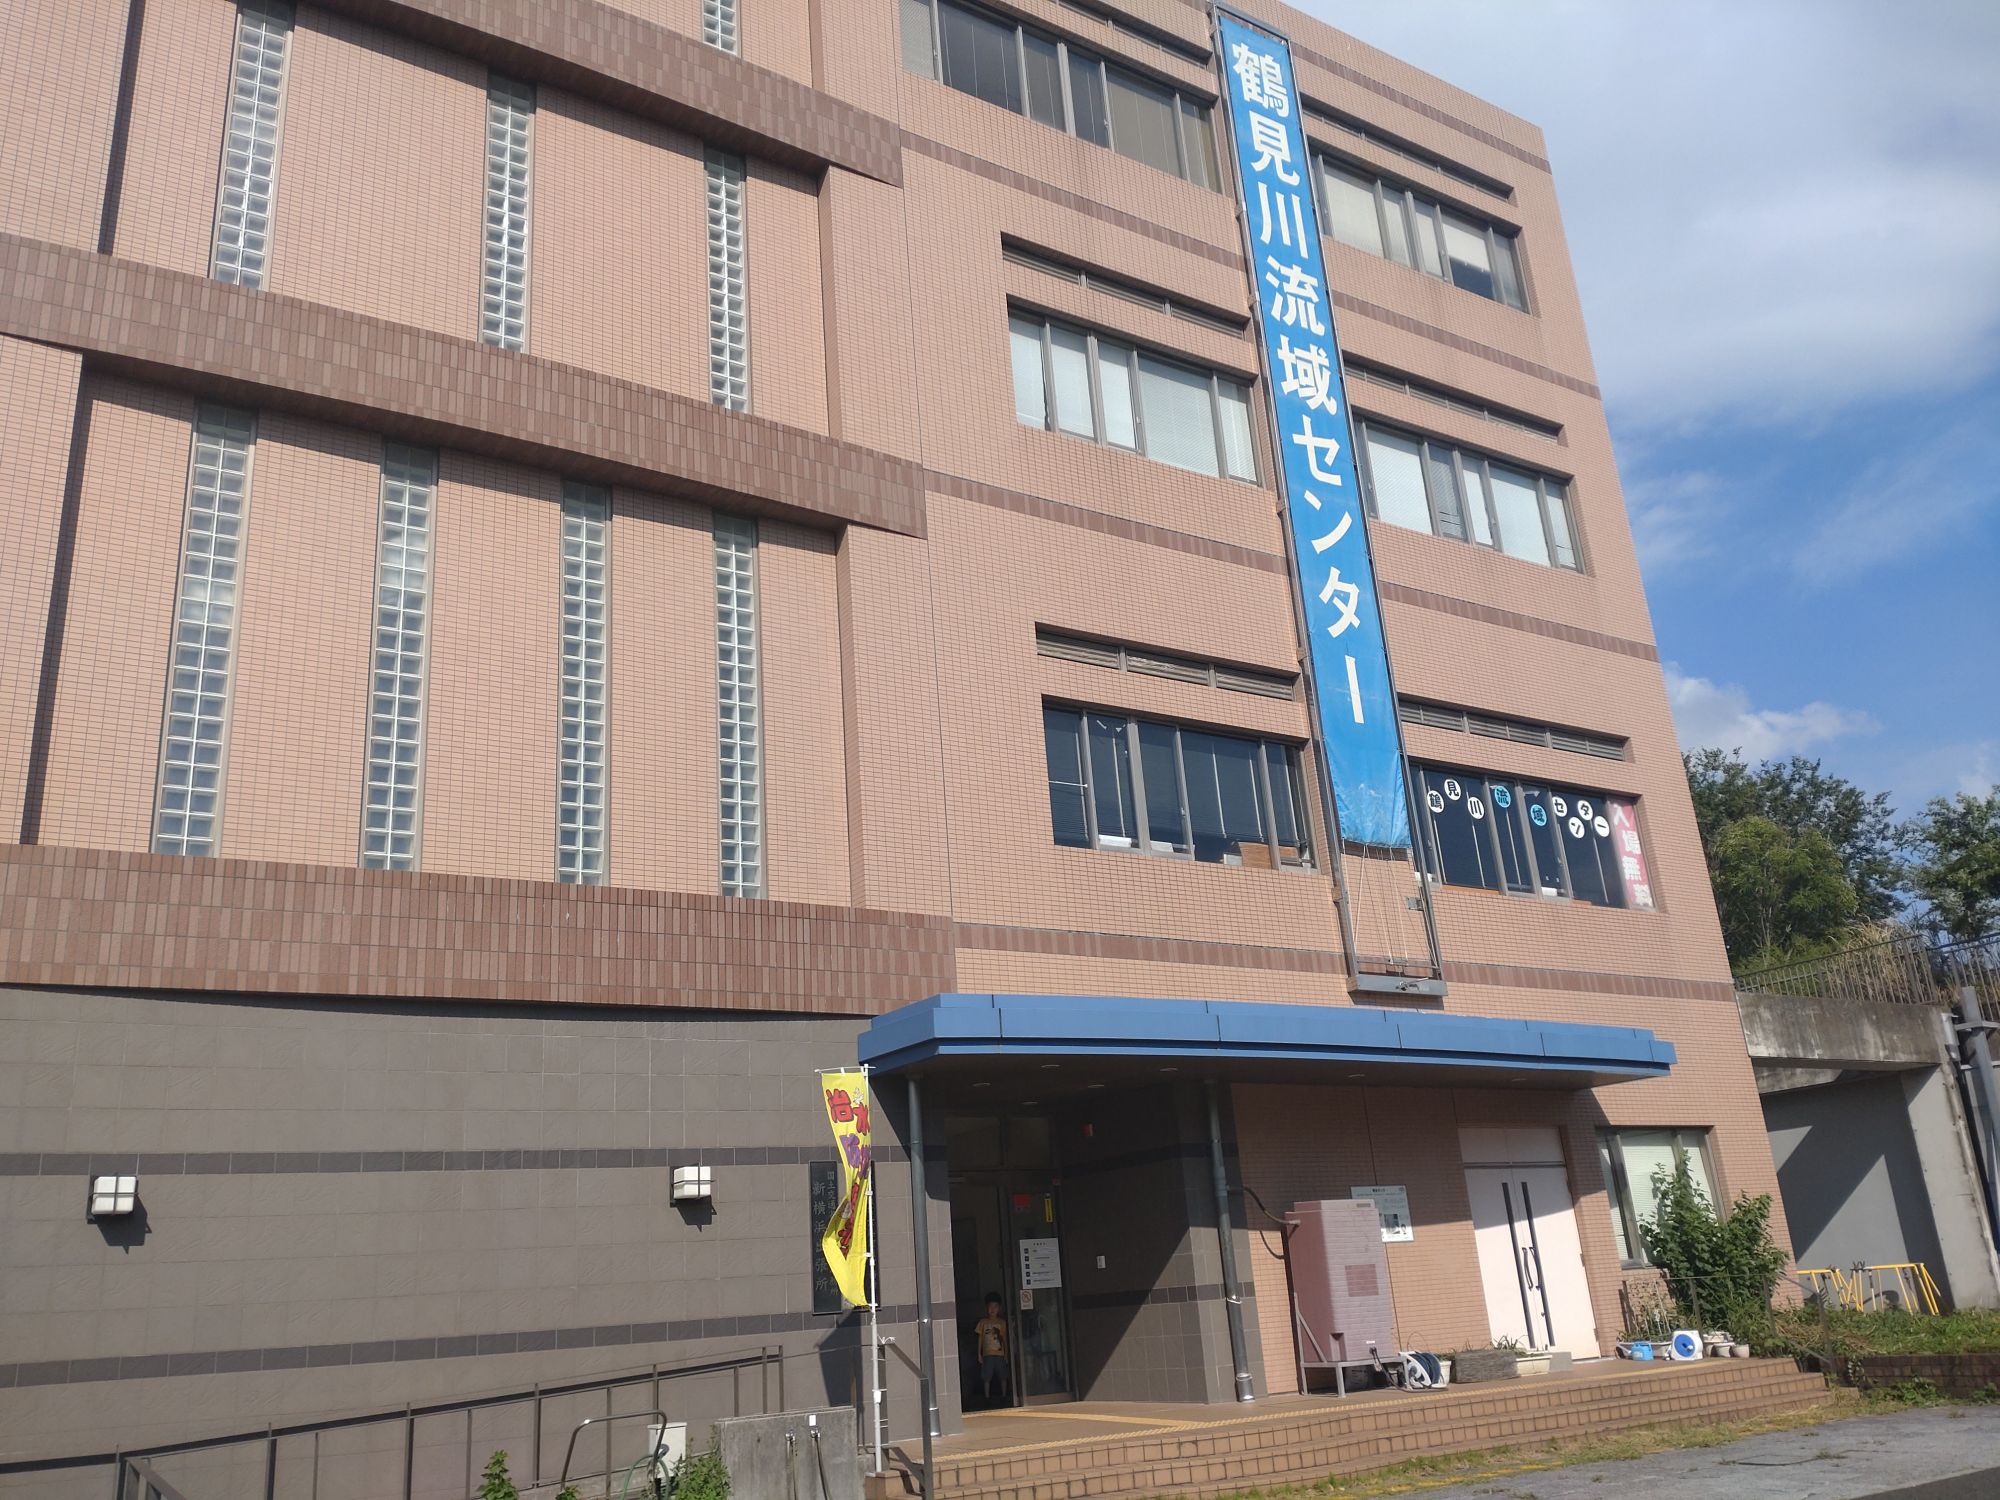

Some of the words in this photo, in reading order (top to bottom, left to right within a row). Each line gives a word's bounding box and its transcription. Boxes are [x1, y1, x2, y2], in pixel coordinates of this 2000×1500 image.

[1231, 41, 1365, 724] 鶴見川流域センター
[1428, 780, 1609, 836] 鶴見川流域センター
